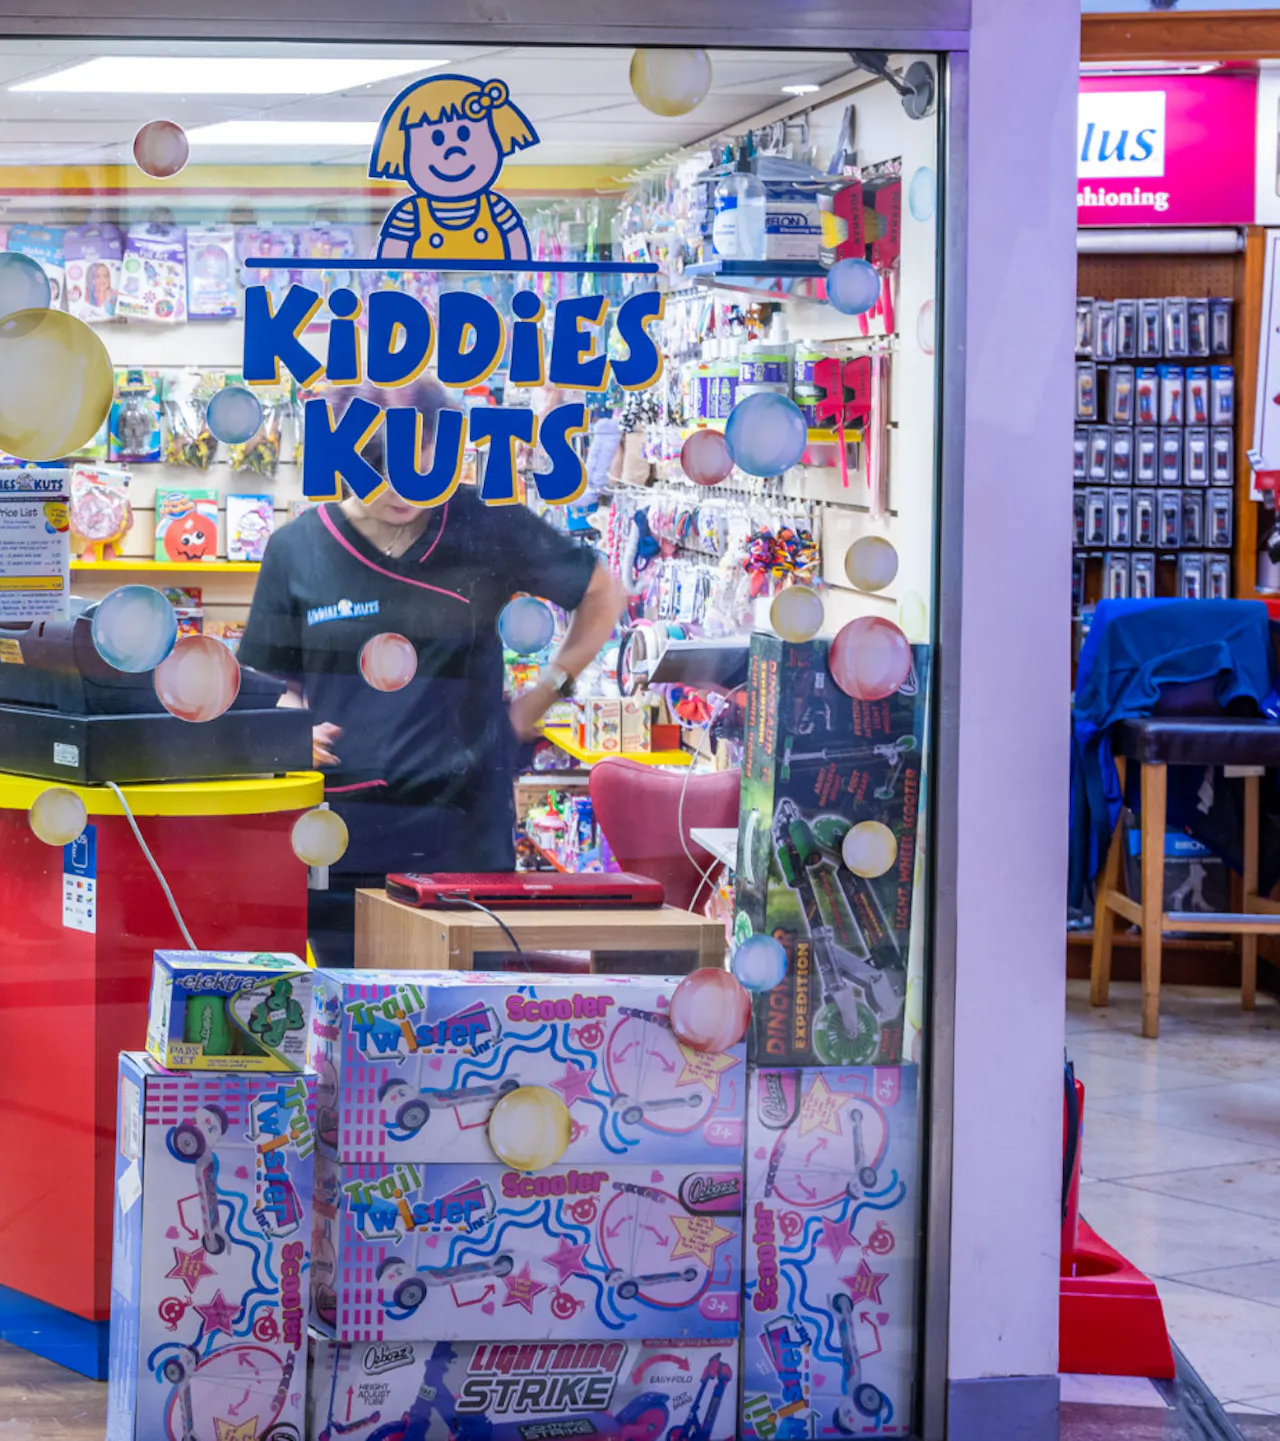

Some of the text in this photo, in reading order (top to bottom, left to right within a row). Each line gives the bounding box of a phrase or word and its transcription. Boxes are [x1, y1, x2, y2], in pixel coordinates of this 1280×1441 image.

[1080, 122, 1157, 162] lus
[1077, 186, 1170, 212] shioning
[302, 397, 590, 508] KUTS
[34, 479, 63, 490] KUTS
[20, 508, 38, 517] List
[896, 886, 910, 929] LIGHT
[347, 982, 426, 1026] Trail
[505, 992, 615, 1024] Scooter
[794, 942, 810, 1049] EXPEDITION
[352, 1010, 490, 1054] Twister
[284, 1078, 316, 1160] Trail
[344, 1163, 423, 1206] Trail
[500, 1169, 609, 1199] Scooter
[349, 1187, 483, 1233] Twister
[752, 1201, 779, 1313] Scooter
[280, 1240, 305, 1351] Scooter
[470, 1342, 624, 1375] LIGHTNING
[358, 1390, 390, 1399] ADJUST
[456, 1377, 614, 1409] STRIKE
